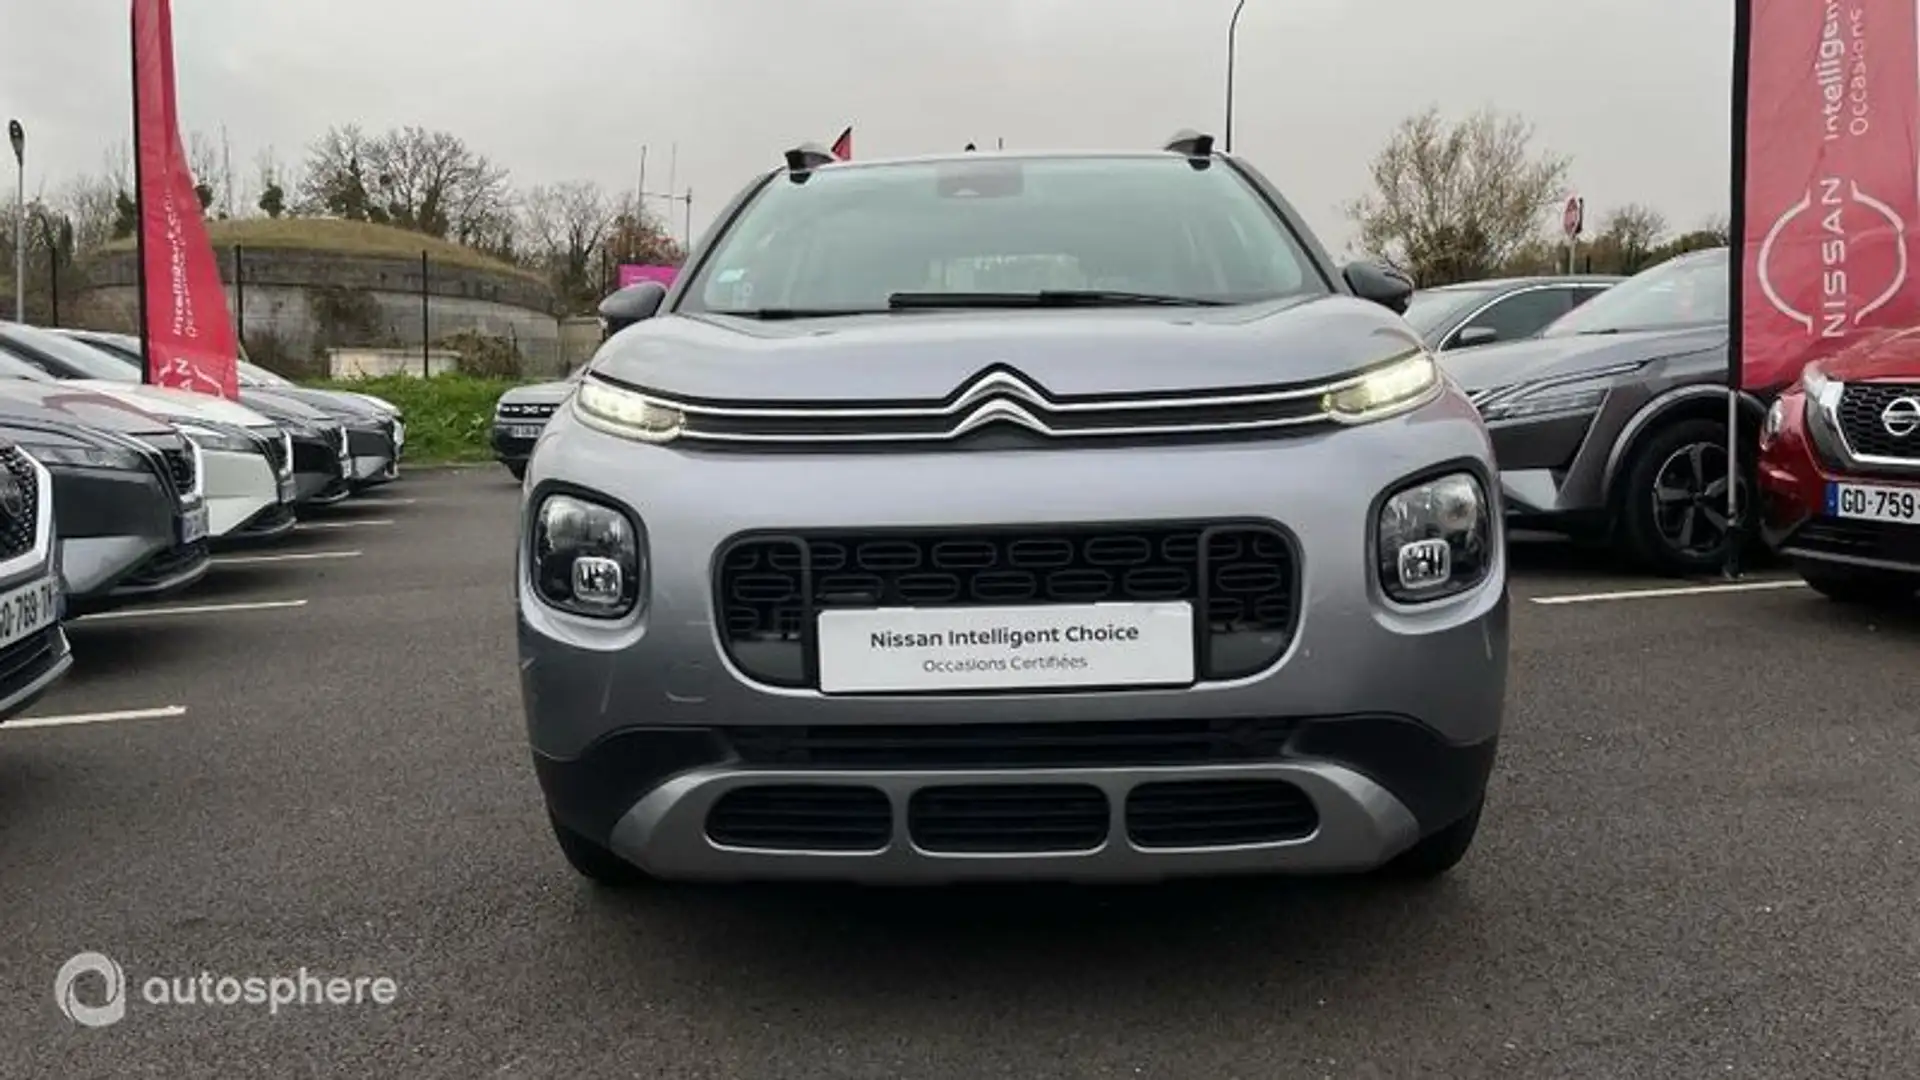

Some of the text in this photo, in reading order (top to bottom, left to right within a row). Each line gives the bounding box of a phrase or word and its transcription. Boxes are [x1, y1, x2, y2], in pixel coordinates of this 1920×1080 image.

[1849, 8, 1869, 137] Occasions
[1820, 177, 1847, 339] NISSAN
[870, 623, 1139, 649] Nissan Intelligent Choice
[923, 656, 1007, 673] Occasions
